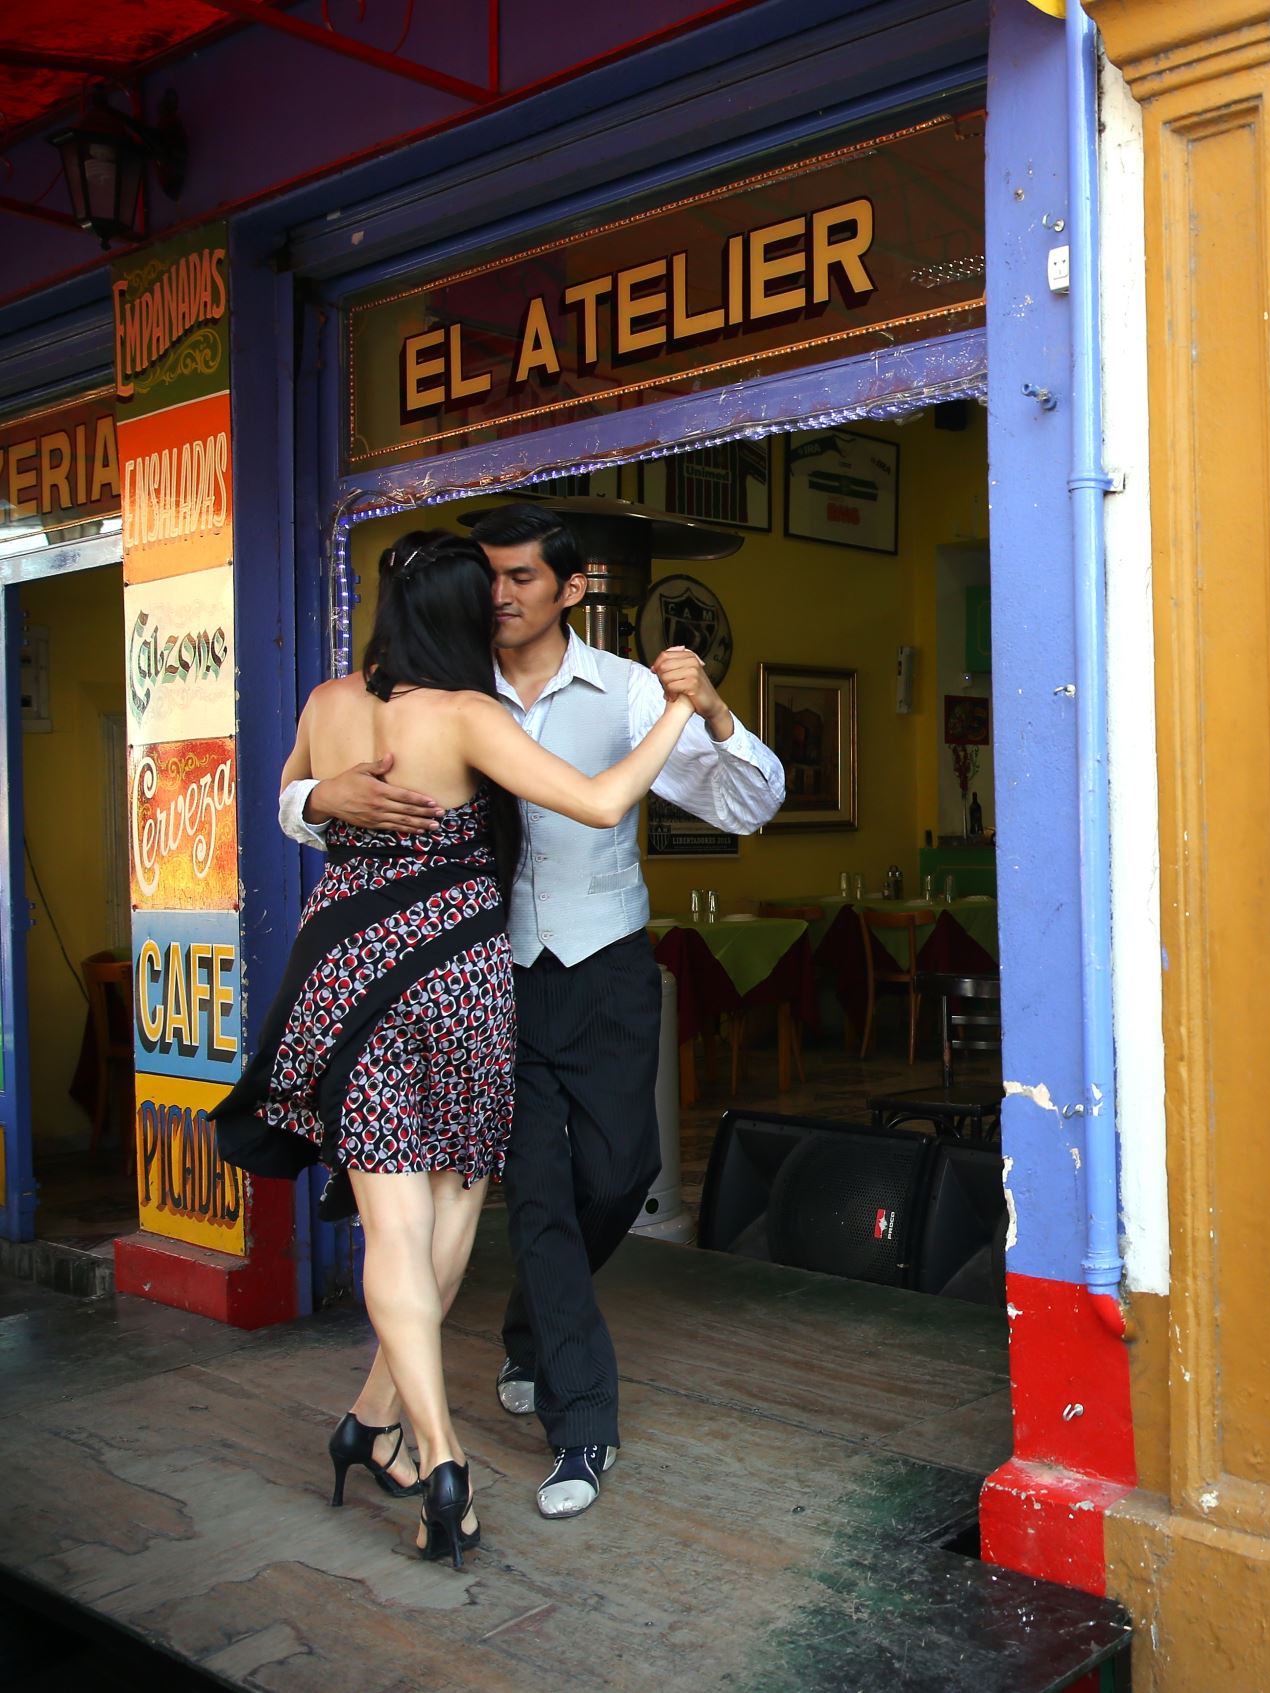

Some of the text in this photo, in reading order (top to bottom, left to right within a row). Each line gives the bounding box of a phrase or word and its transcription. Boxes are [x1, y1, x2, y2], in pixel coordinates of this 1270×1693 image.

[112, 248, 226, 397] EMPANADAS
[403, 197, 876, 417] EL ATELIER
[0, 414, 121, 525] ERIA
[124, 431, 228, 549] ENSALADAS
[129, 609, 228, 727] Calzone
[132, 756, 235, 896] Cerveza
[136, 938, 238, 1059] CAFE
